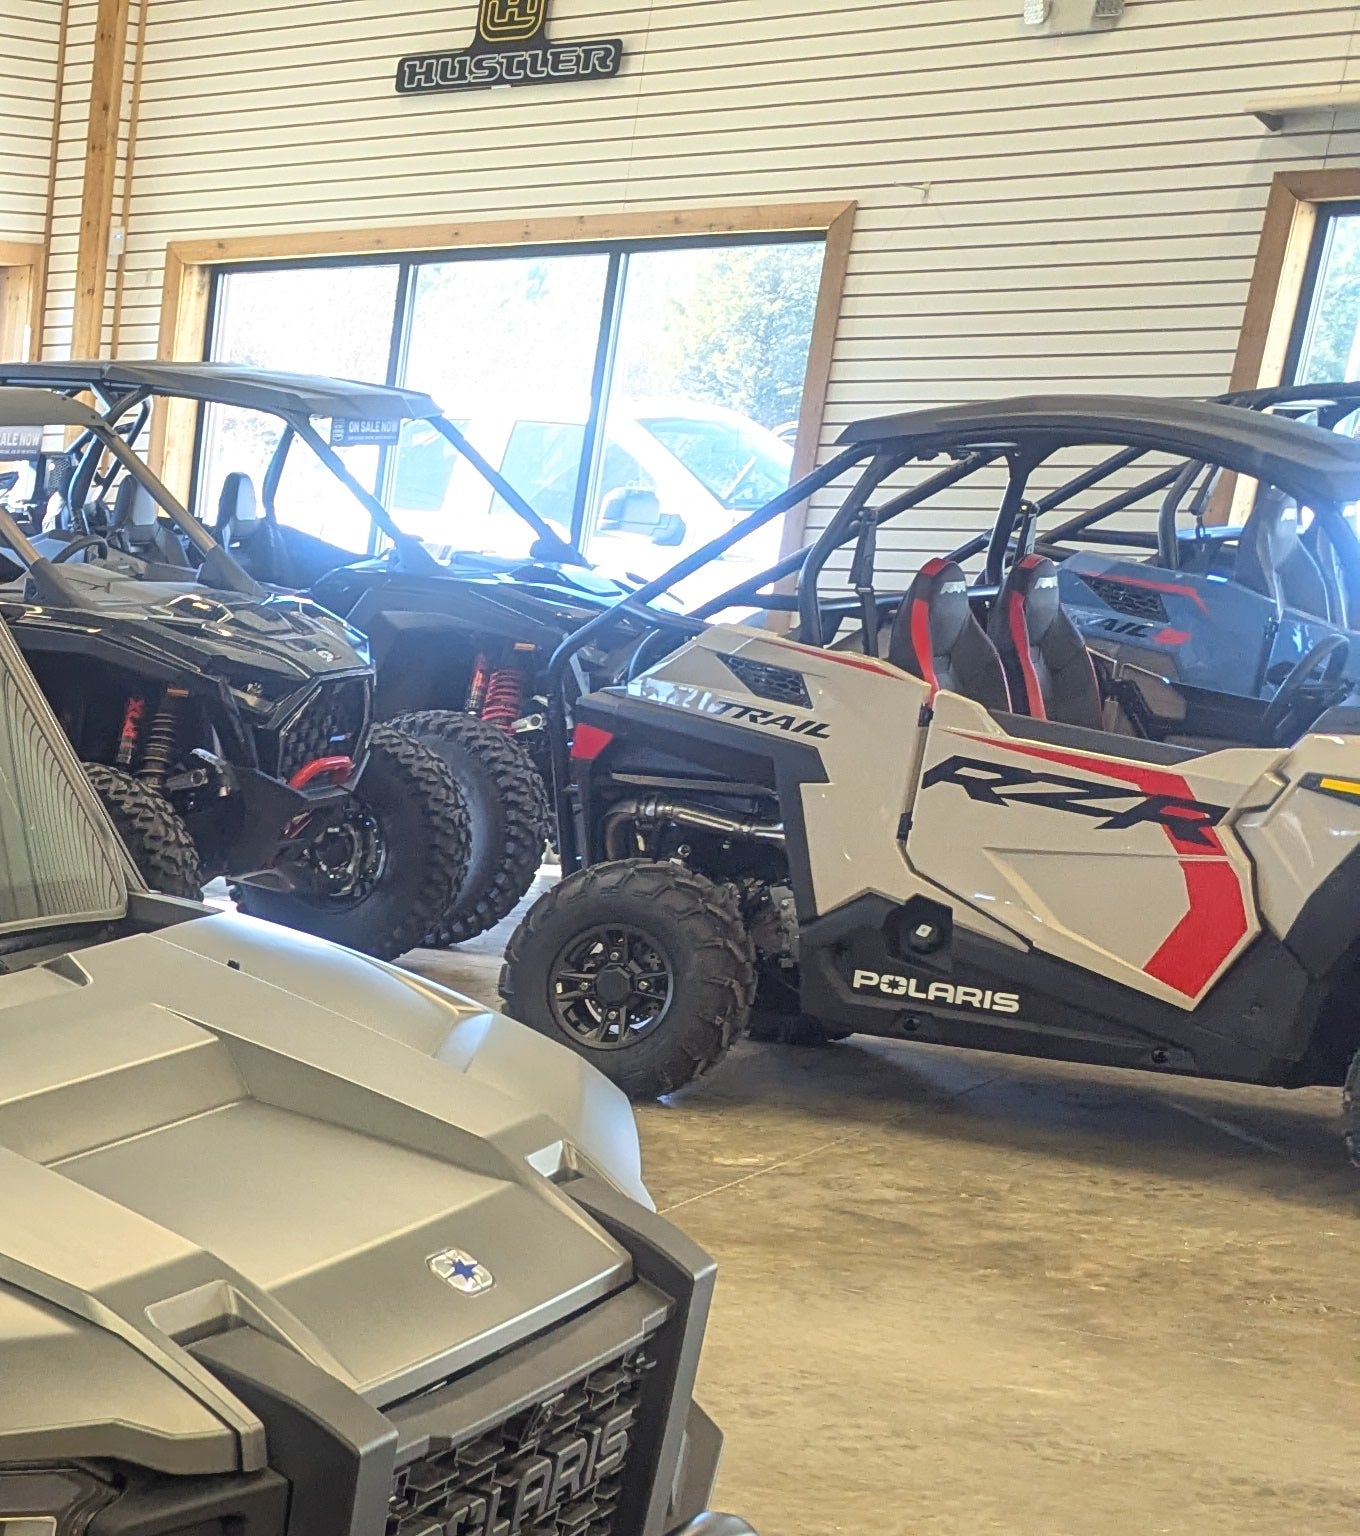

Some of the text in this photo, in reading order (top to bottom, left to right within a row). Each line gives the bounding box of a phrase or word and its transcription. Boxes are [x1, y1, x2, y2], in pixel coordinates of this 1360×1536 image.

[404, 44, 616, 89] HUSTLER
[19, 431, 41, 447] NOW
[348, 420, 360, 433] ON
[360, 420, 380, 433] SALE
[381, 420, 398, 433] NOW
[714, 701, 831, 739] TRAIL
[922, 754, 1231, 848] RZR
[853, 968, 1020, 1014] POLARIS
